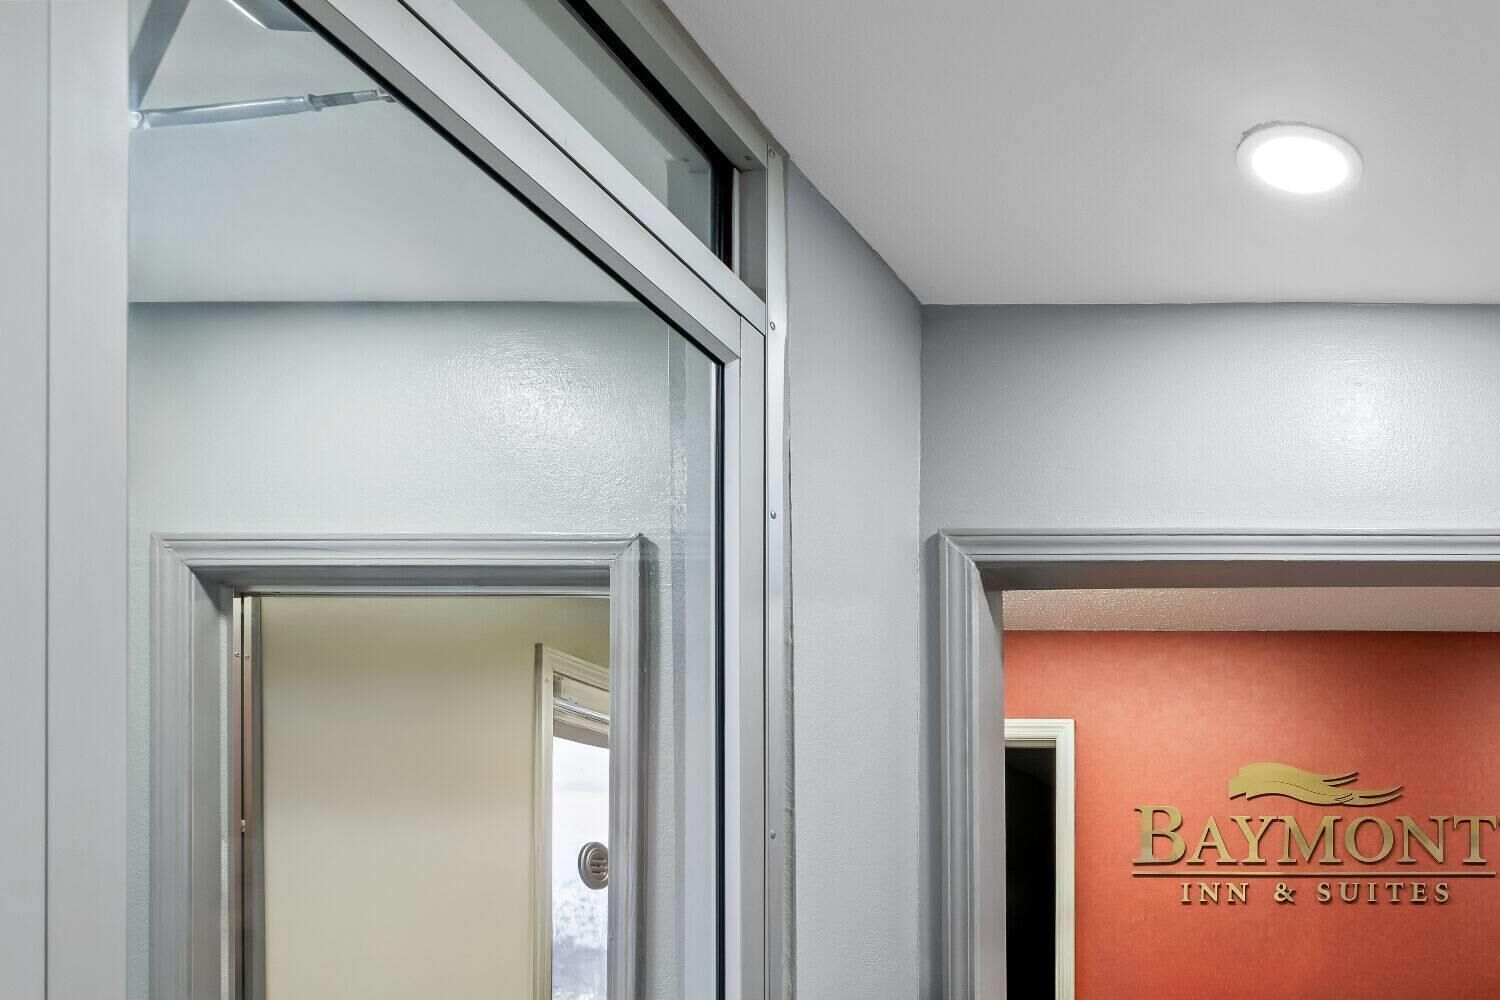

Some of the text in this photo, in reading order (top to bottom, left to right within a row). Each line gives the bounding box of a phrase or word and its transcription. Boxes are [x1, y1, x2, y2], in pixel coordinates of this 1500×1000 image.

[1181, 882, 1450, 903] INN & SUITES
